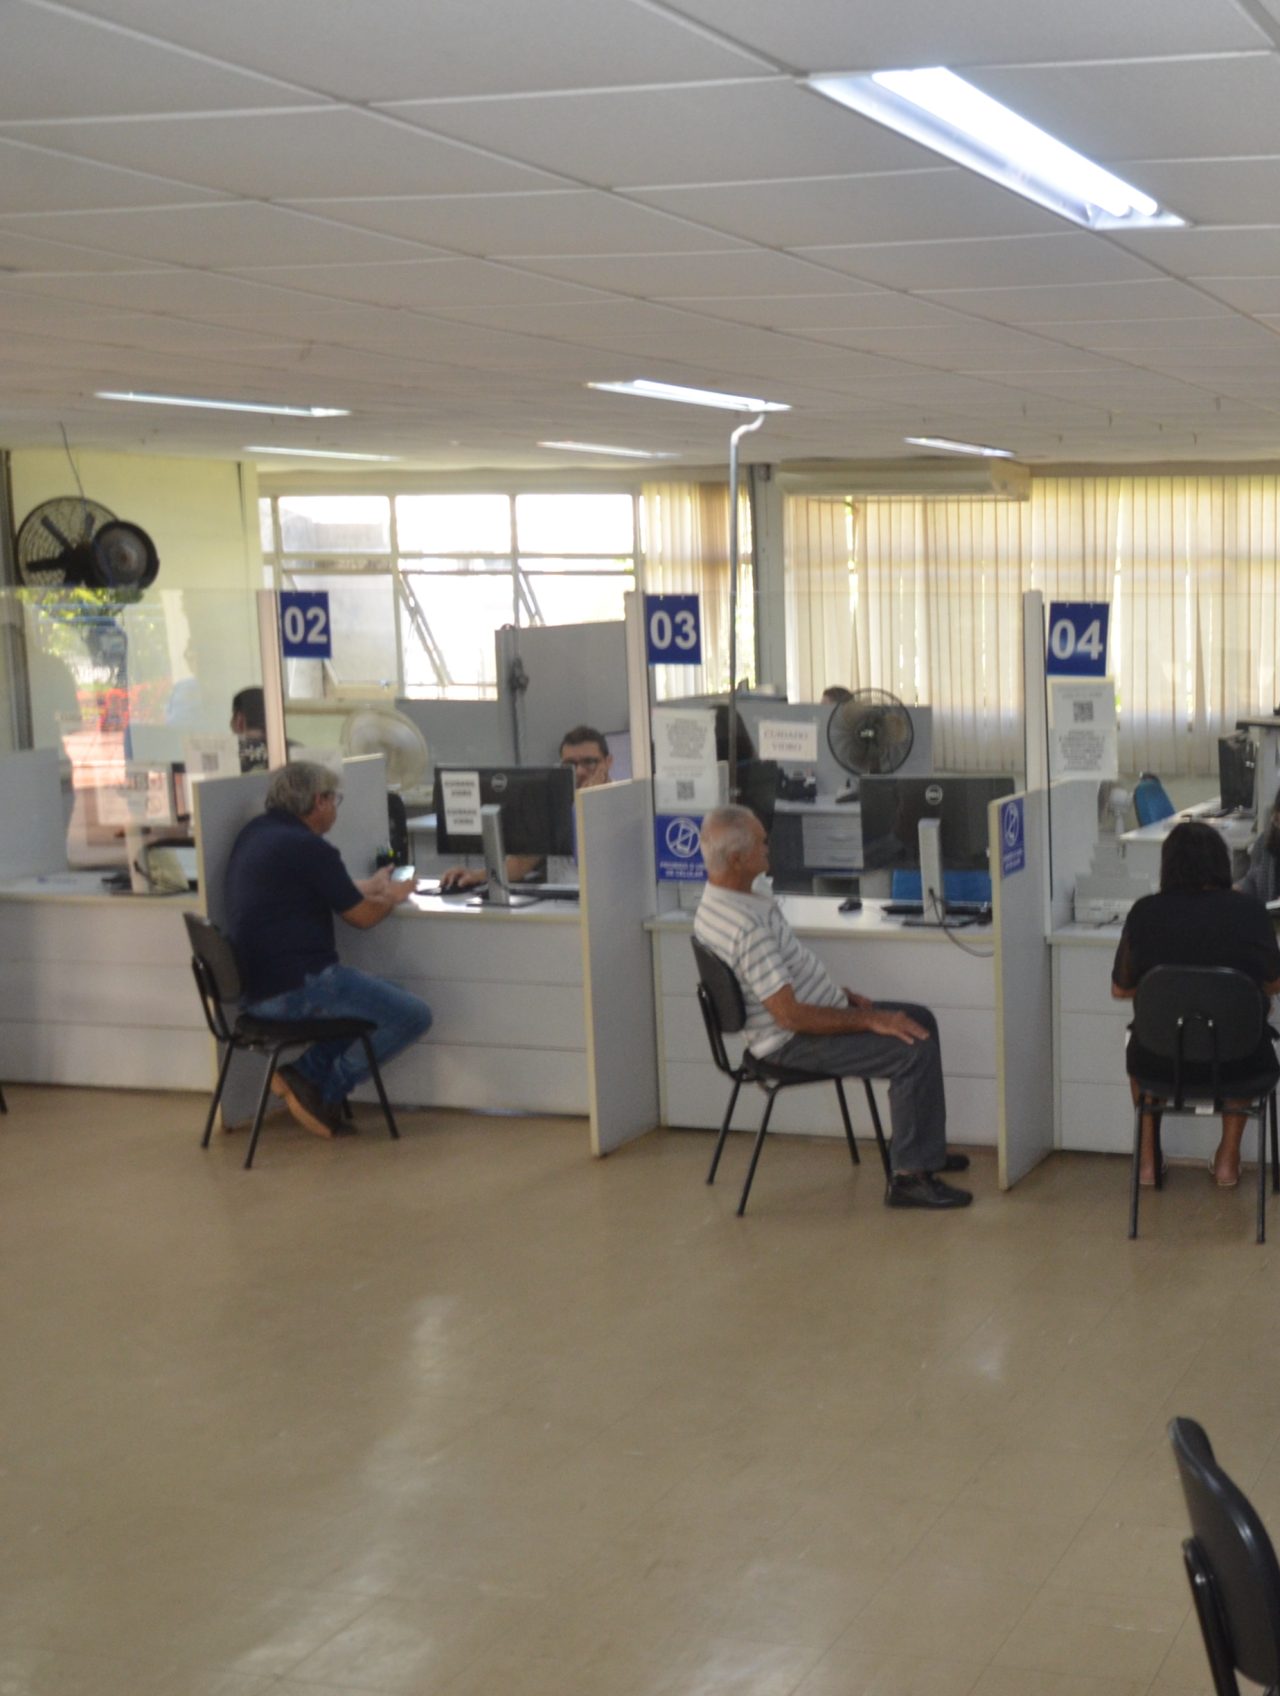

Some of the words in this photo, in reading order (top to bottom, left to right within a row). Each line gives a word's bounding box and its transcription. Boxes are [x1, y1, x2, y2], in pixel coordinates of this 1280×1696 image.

[284, 606, 328, 644] 02
[650, 610, 697, 650] 03
[1051, 618, 1104, 661] 04
